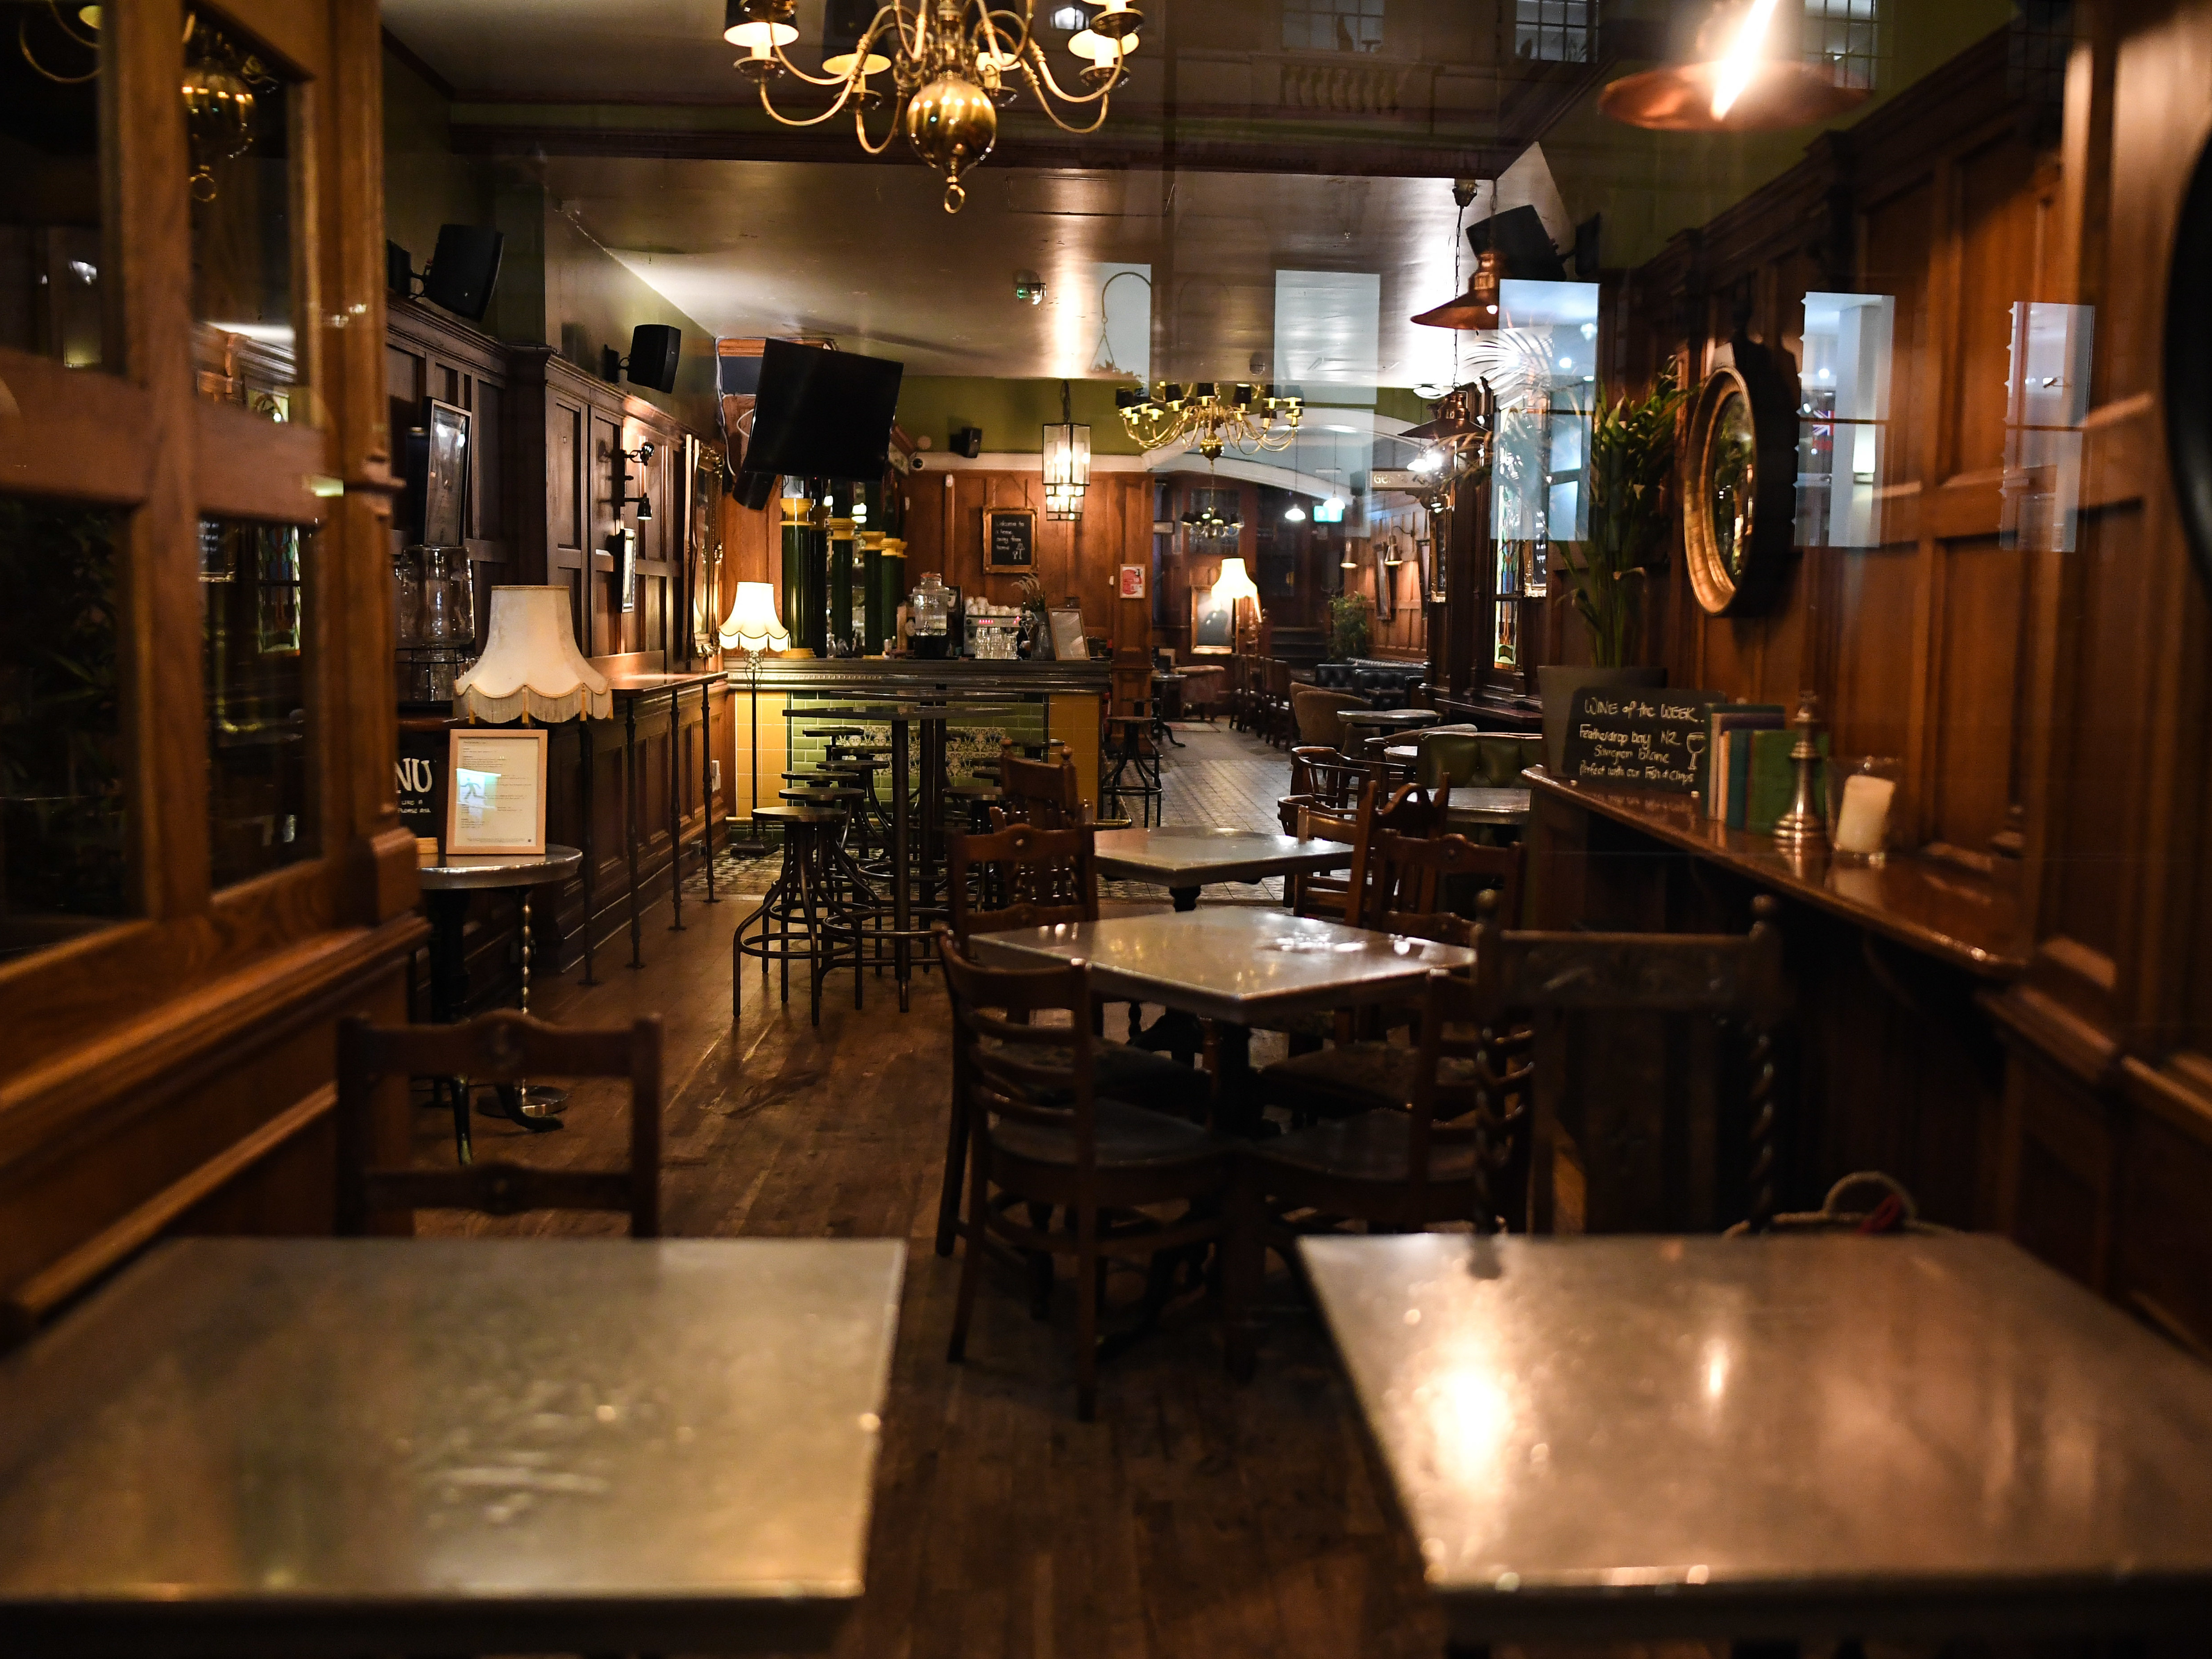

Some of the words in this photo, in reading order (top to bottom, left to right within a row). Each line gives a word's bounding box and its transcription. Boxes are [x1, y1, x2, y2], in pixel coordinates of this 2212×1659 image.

[1584, 697, 1618, 715] WINE
[1622, 701, 1637, 719] of
[1637, 702, 1656, 717] the
[1607, 766, 1625, 777] with
[1626, 768, 1641, 778] our
